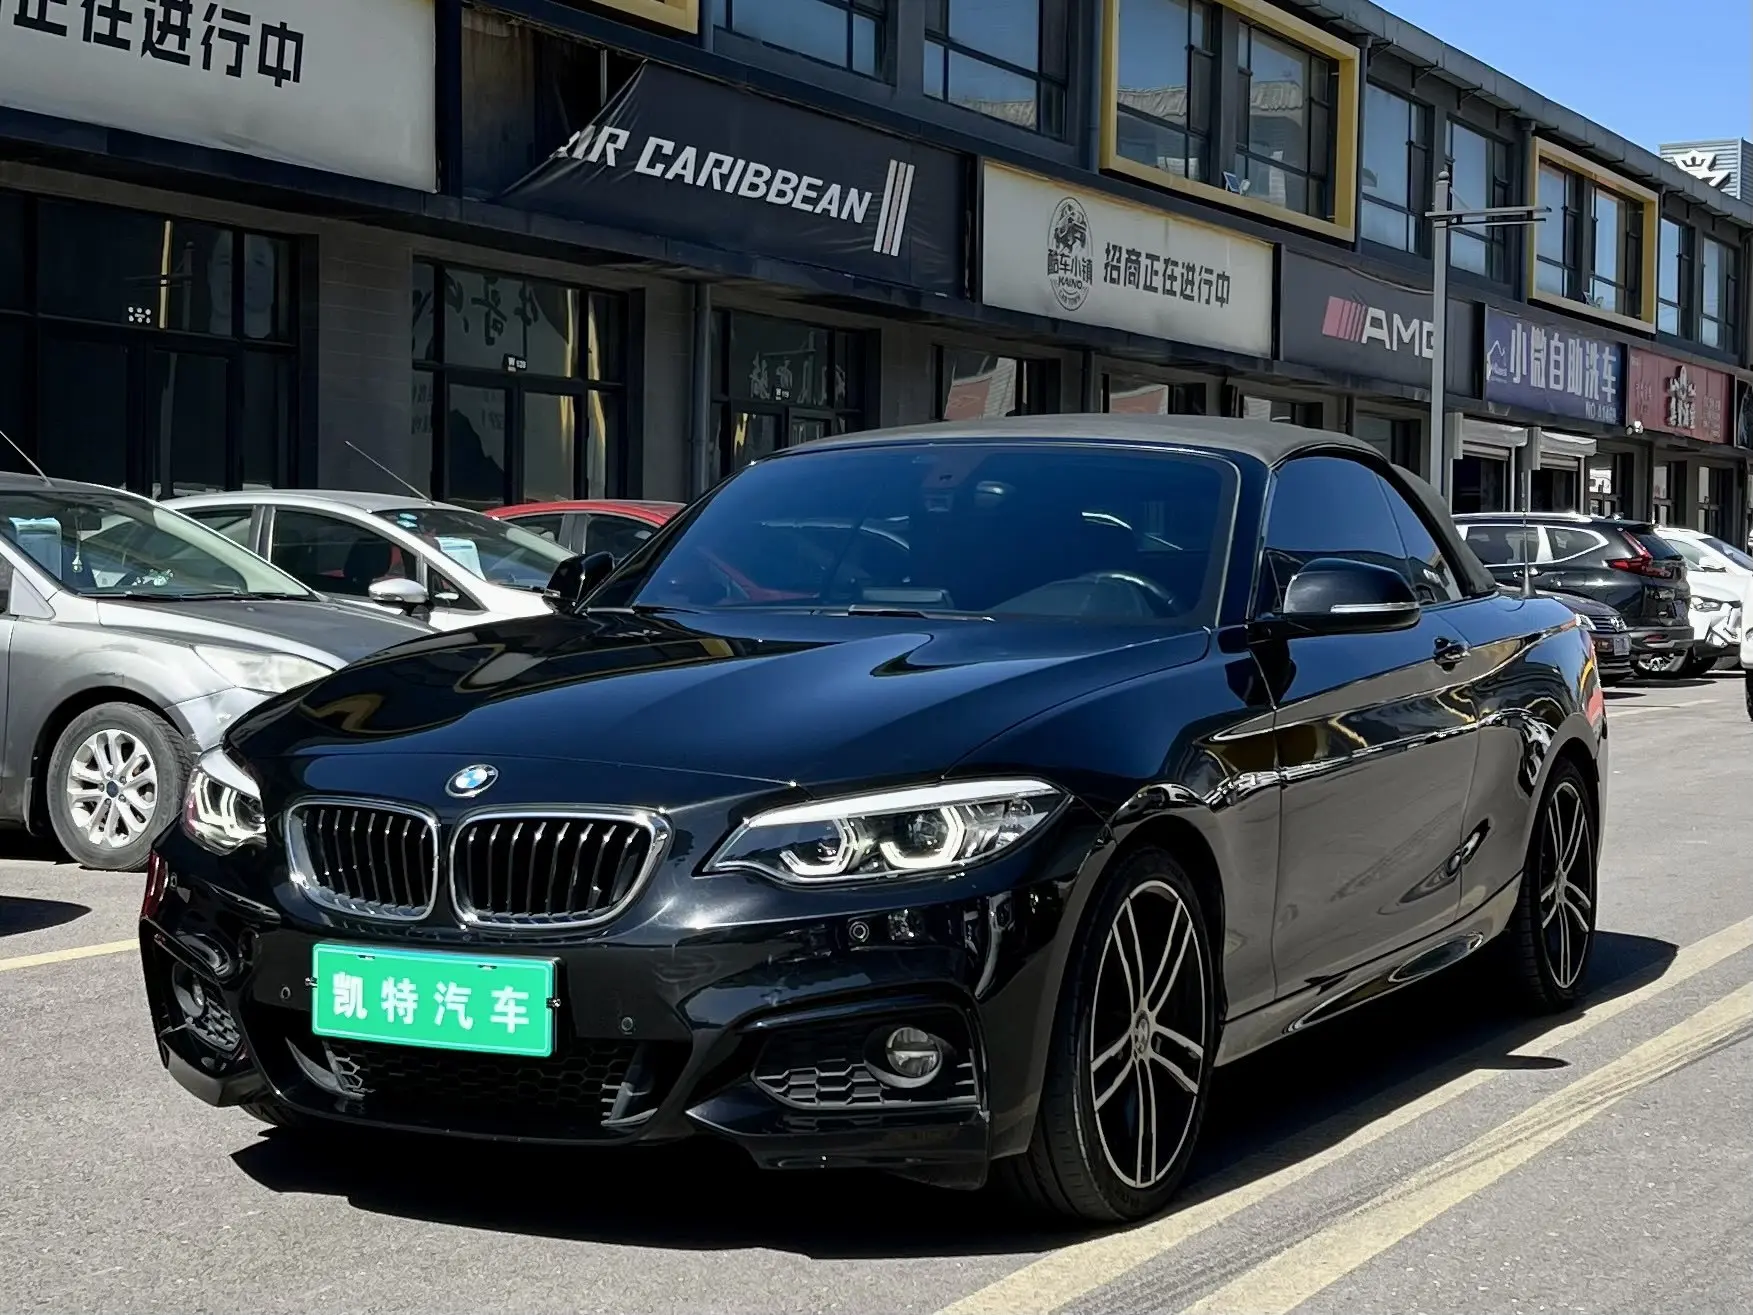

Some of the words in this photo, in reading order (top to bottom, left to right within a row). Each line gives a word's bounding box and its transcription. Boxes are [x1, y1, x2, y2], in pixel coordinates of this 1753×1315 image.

[635, 136, 872, 223] CARIBBEAN
[1103, 242, 1230, 308] 招商正在进行中
[332, 971, 530, 1034] 凯特汽车
